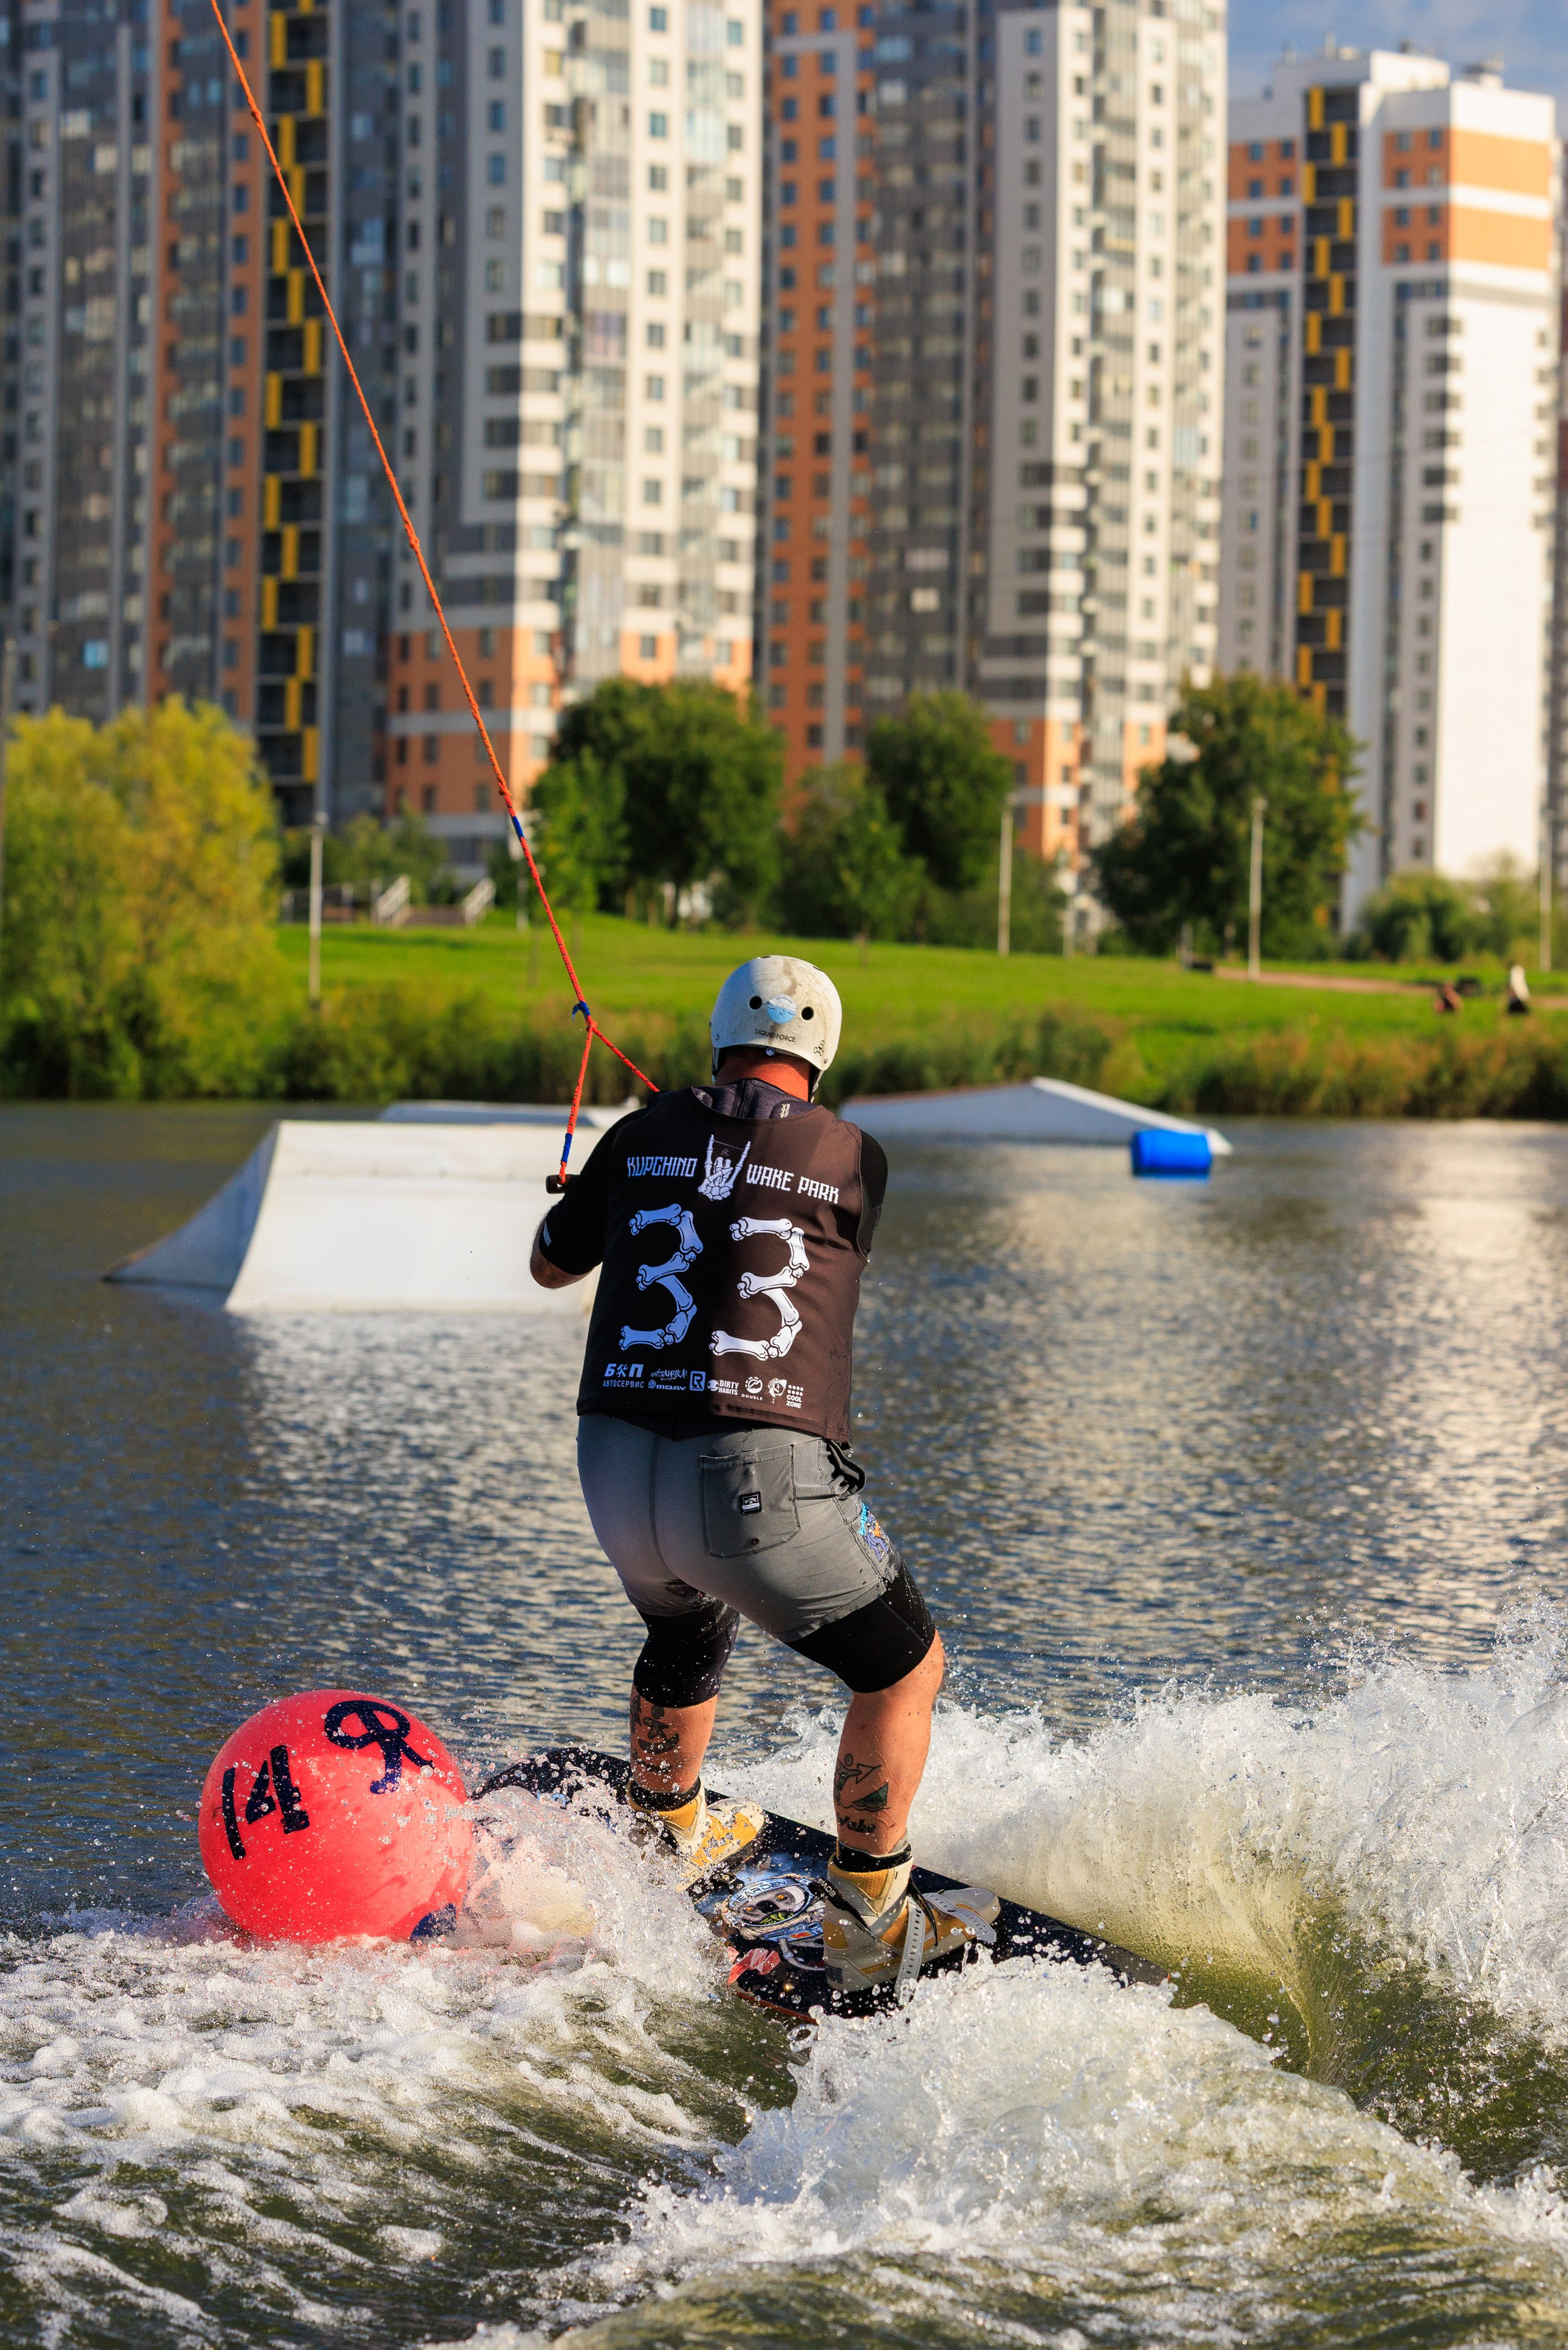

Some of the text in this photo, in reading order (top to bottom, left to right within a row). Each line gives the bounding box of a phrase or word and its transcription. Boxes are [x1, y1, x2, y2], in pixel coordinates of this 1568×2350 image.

[755, 1029, 796, 1042] LIQUID FORCE
[627, 1156, 840, 1204] KUPCHINO WAKE PARK
[603, 1380, 644, 1388] АВТОСЕРВИС
[719, 1379, 739, 1389] DIRTY
[786, 1395, 802, 1403] COOL
[786, 1400, 802, 1409] ZONE
[732, 1880, 786, 1907] BEARDEN
